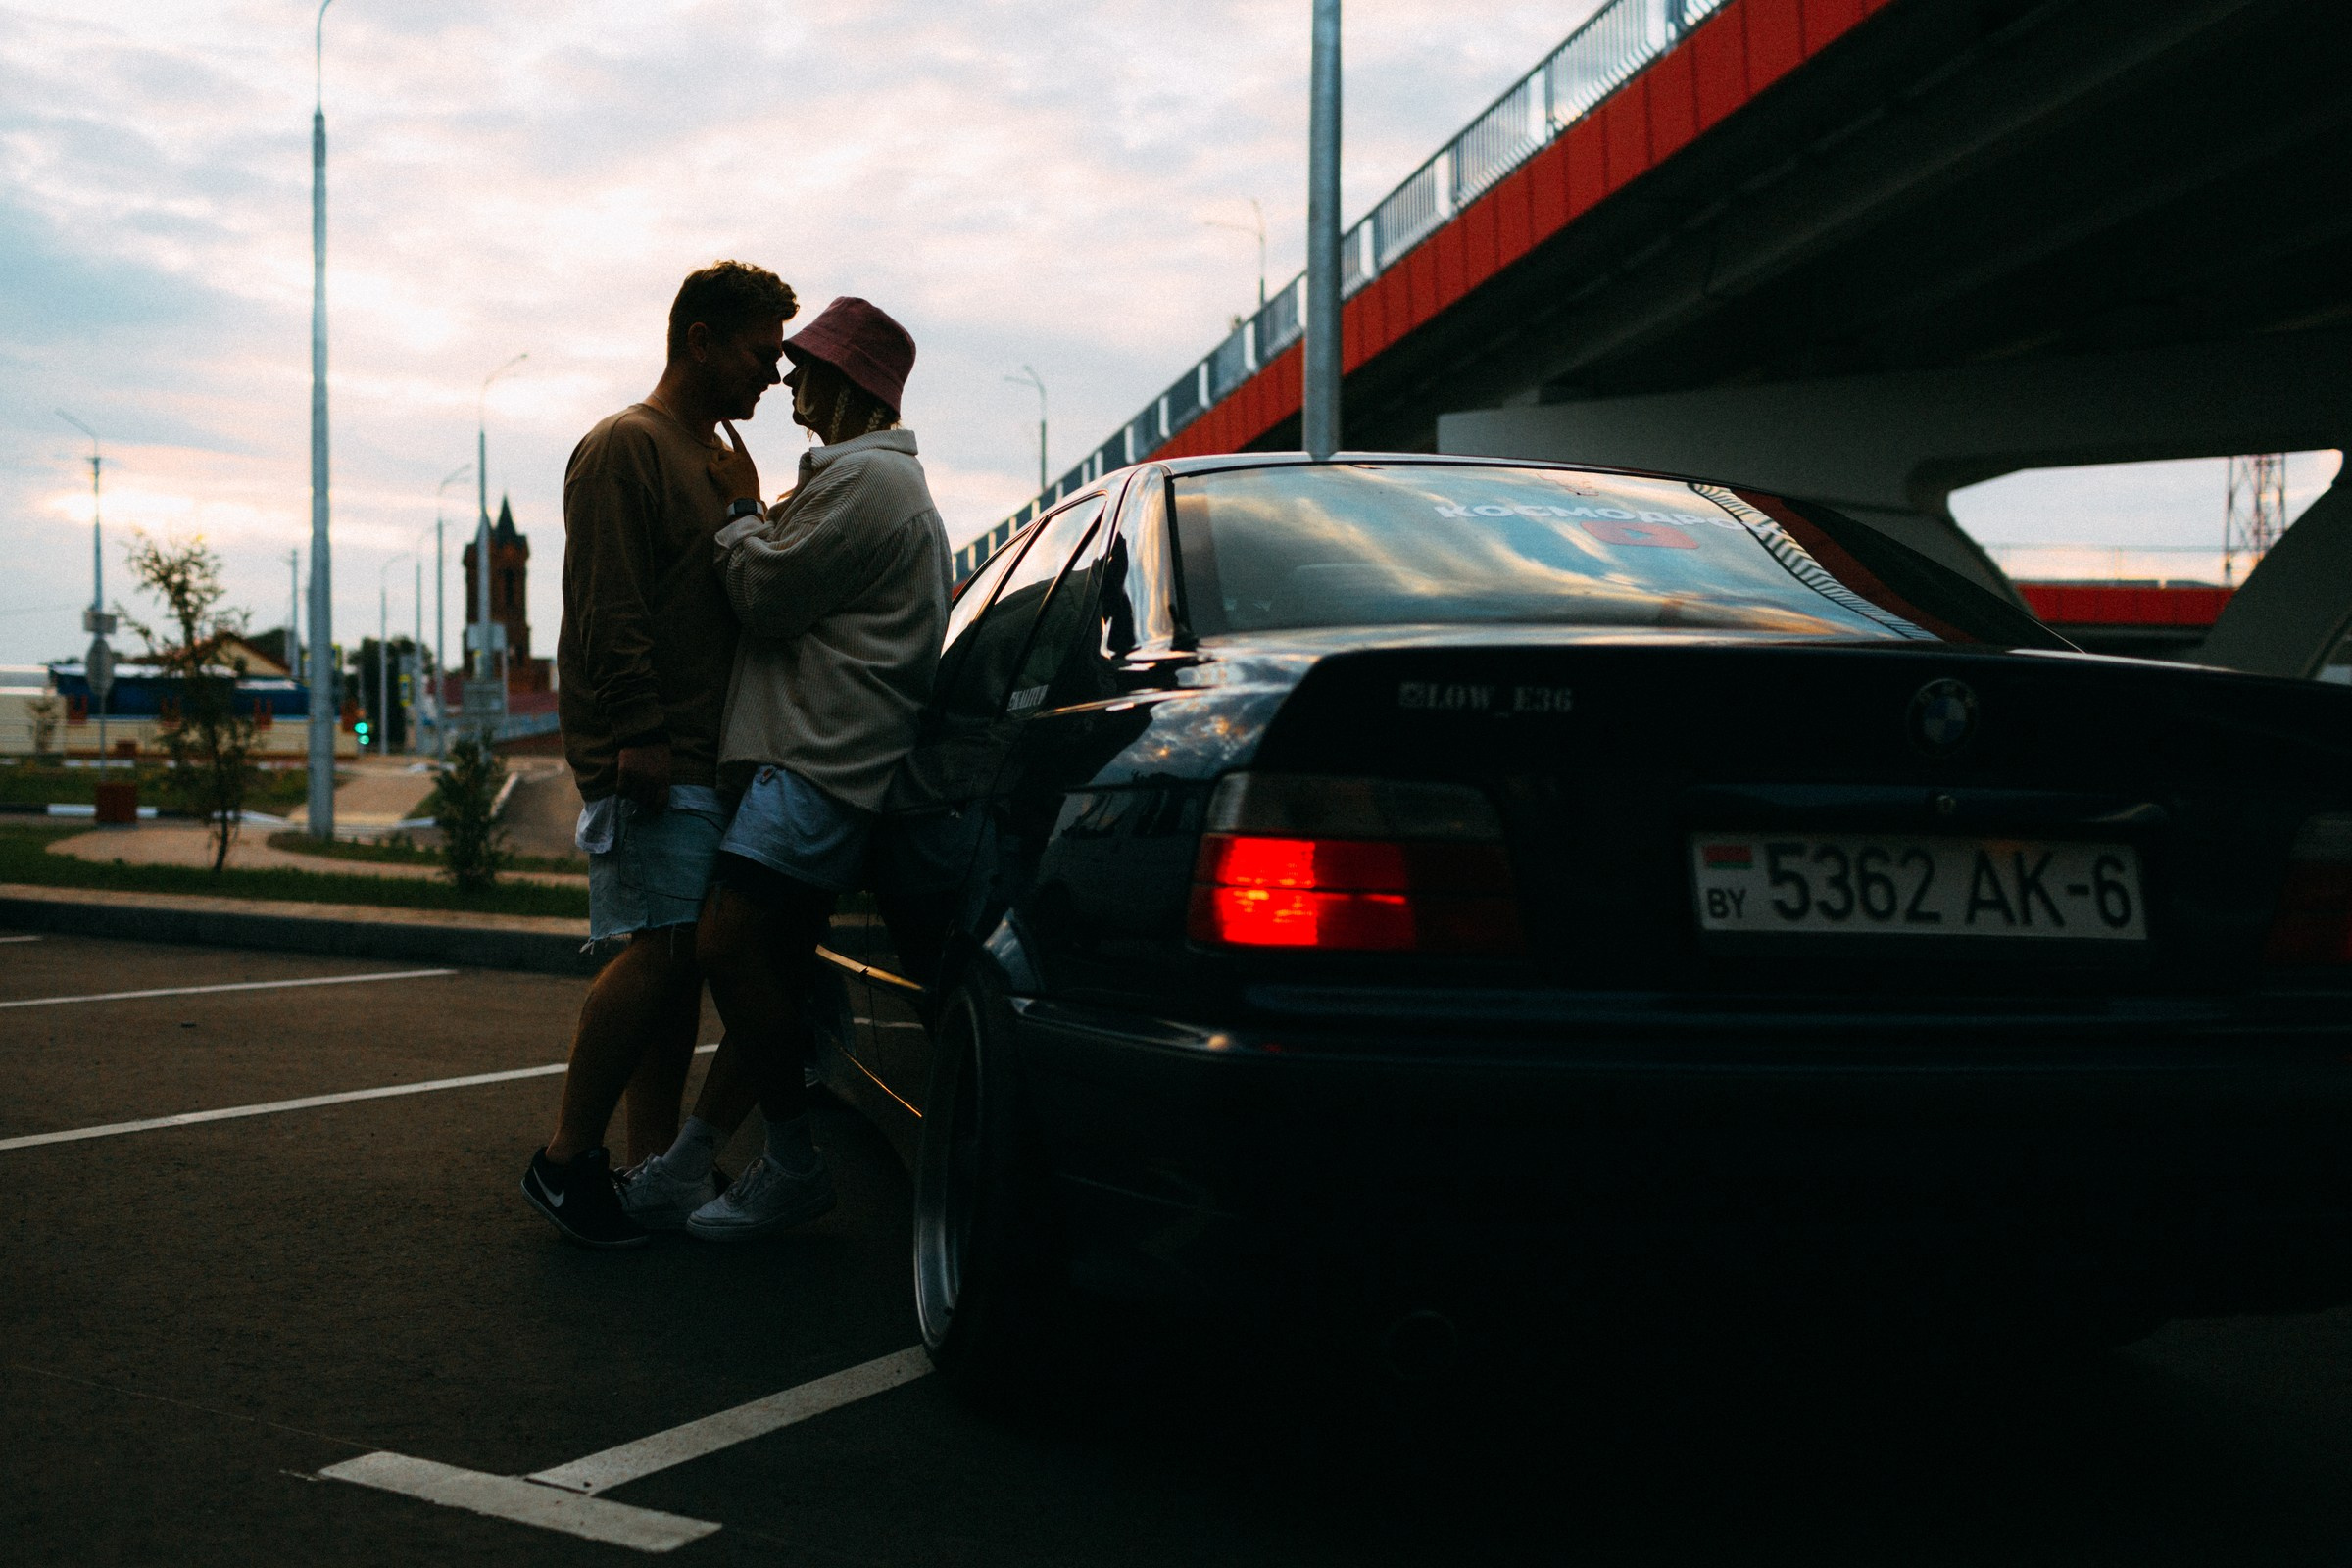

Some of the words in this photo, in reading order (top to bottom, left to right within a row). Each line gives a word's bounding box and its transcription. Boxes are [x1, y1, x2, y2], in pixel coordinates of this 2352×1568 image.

[1706, 888, 1746, 919] BY
[1767, 842, 1941, 924] 5362
[1965, 849, 2133, 928] AK-6
